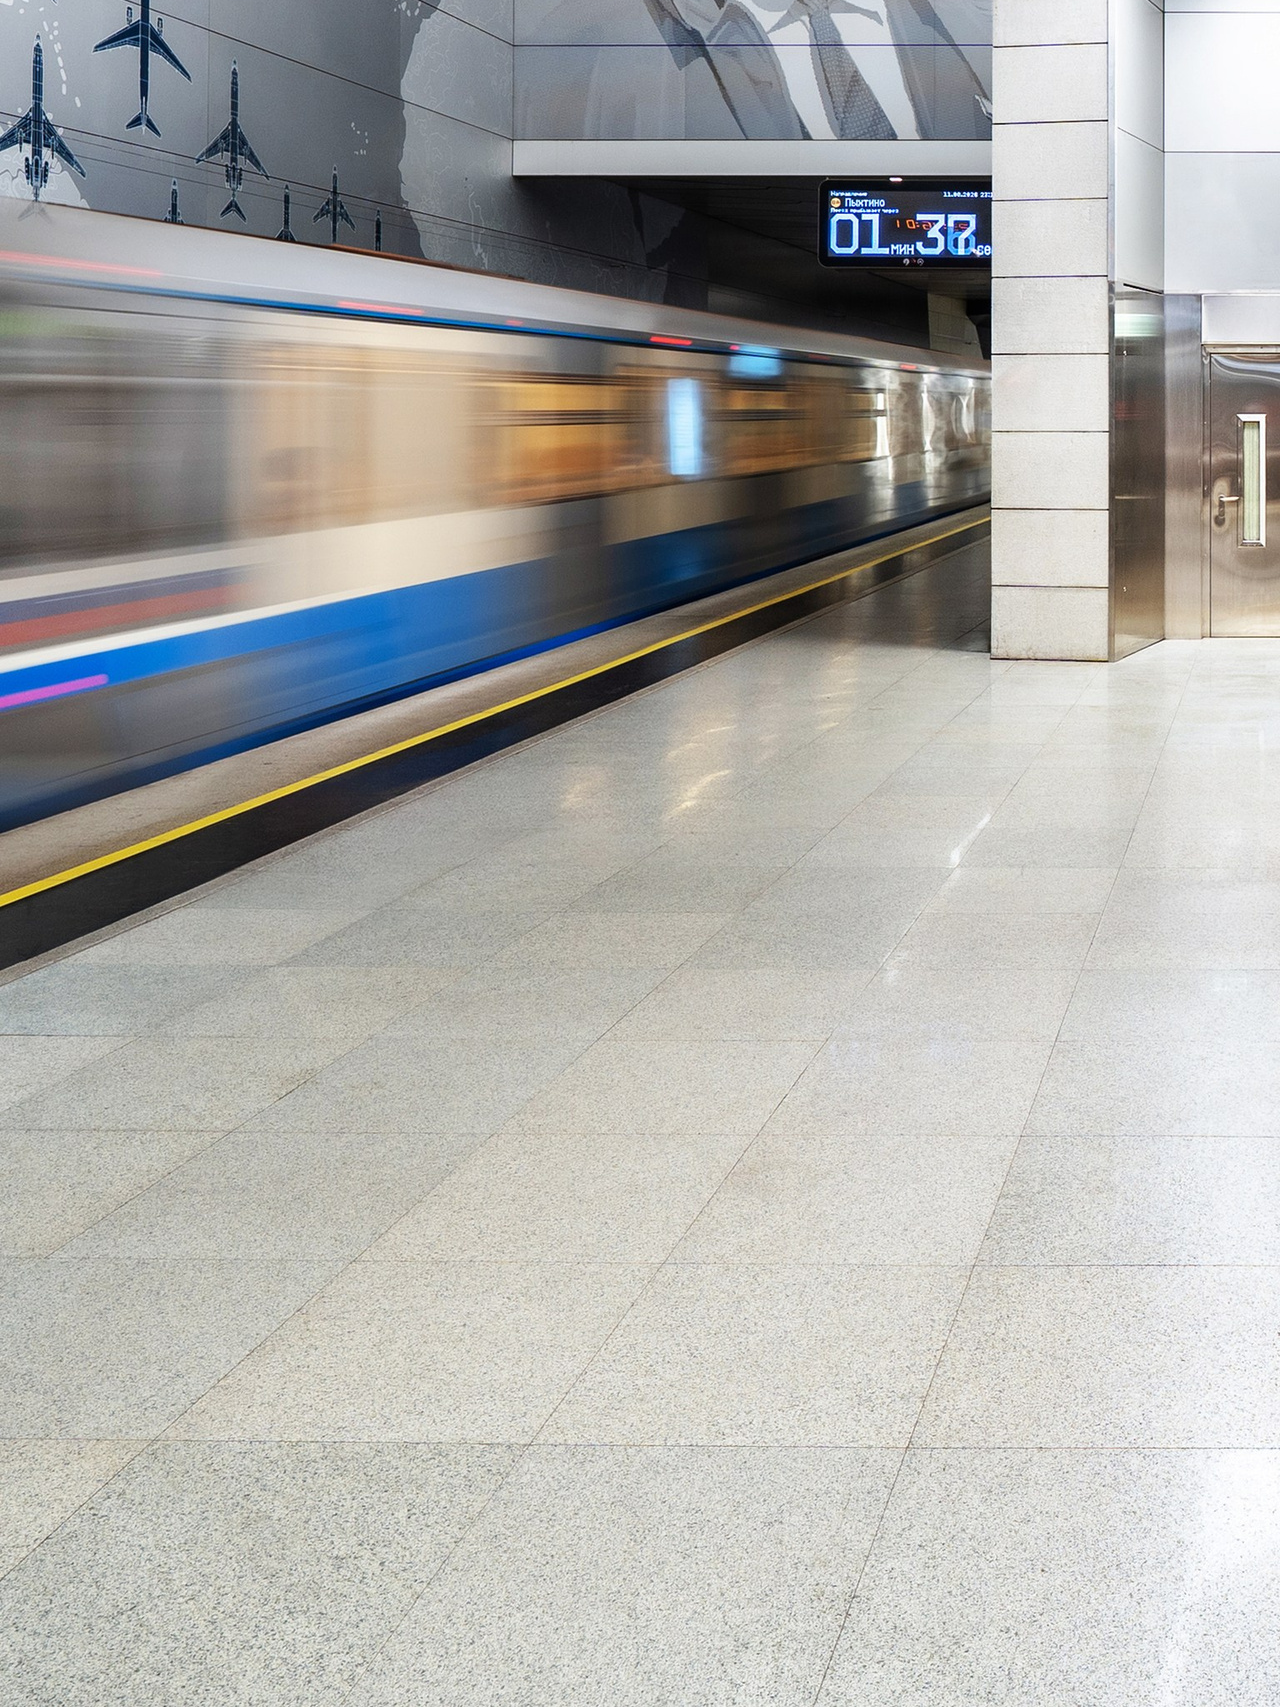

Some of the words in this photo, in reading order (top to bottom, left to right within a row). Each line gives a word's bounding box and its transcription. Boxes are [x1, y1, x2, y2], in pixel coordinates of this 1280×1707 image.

[844, 197, 886, 208] Пыхтино
[830, 213, 890, 255] 01
[891, 244, 915, 255] мин
